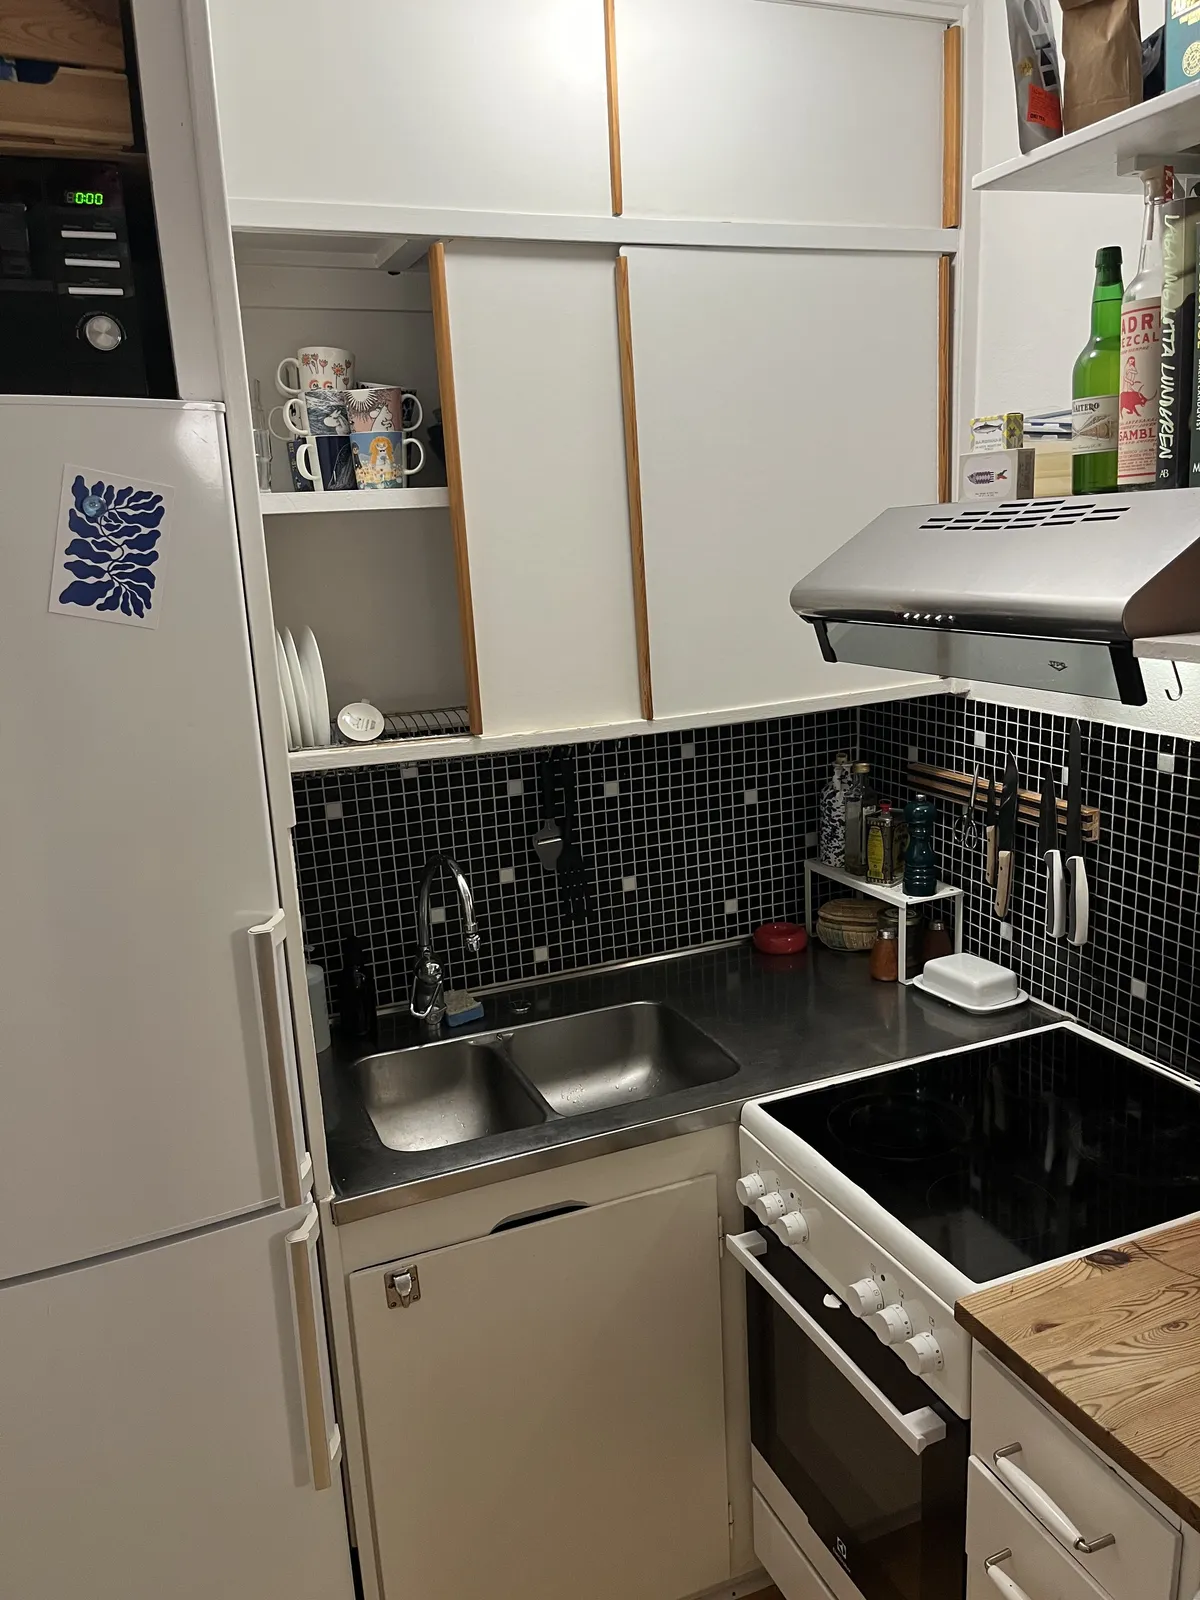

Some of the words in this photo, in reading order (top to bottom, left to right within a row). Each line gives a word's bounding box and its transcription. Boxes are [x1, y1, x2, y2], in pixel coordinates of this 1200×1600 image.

[75, 192, 103, 205] 0:00
[1161, 304, 1177, 357] LOTTA
[1158, 363, 1176, 460] LUNDGREN
